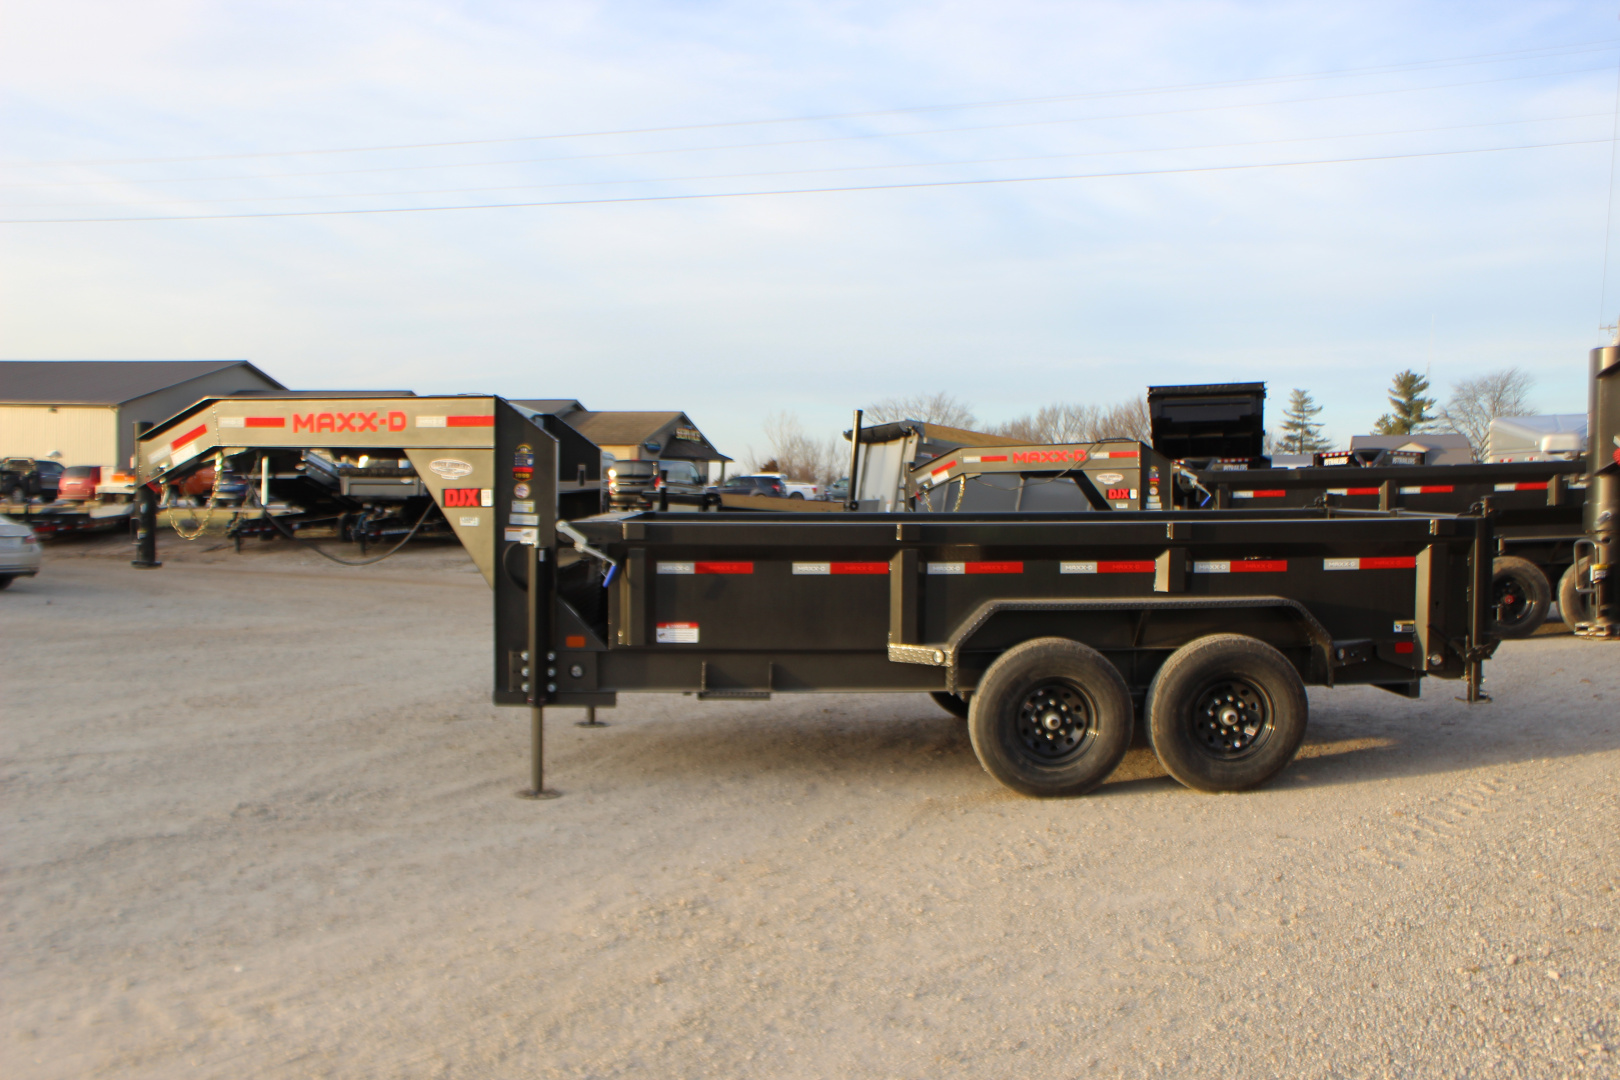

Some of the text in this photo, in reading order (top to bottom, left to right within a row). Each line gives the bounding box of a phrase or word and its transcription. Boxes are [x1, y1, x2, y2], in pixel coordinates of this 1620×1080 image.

[293, 411, 407, 433] MAXX-D
[1013, 449, 1087, 464] MAXX-D
[444, 488, 479, 507] DJX
[1108, 488, 1130, 500] DJX
